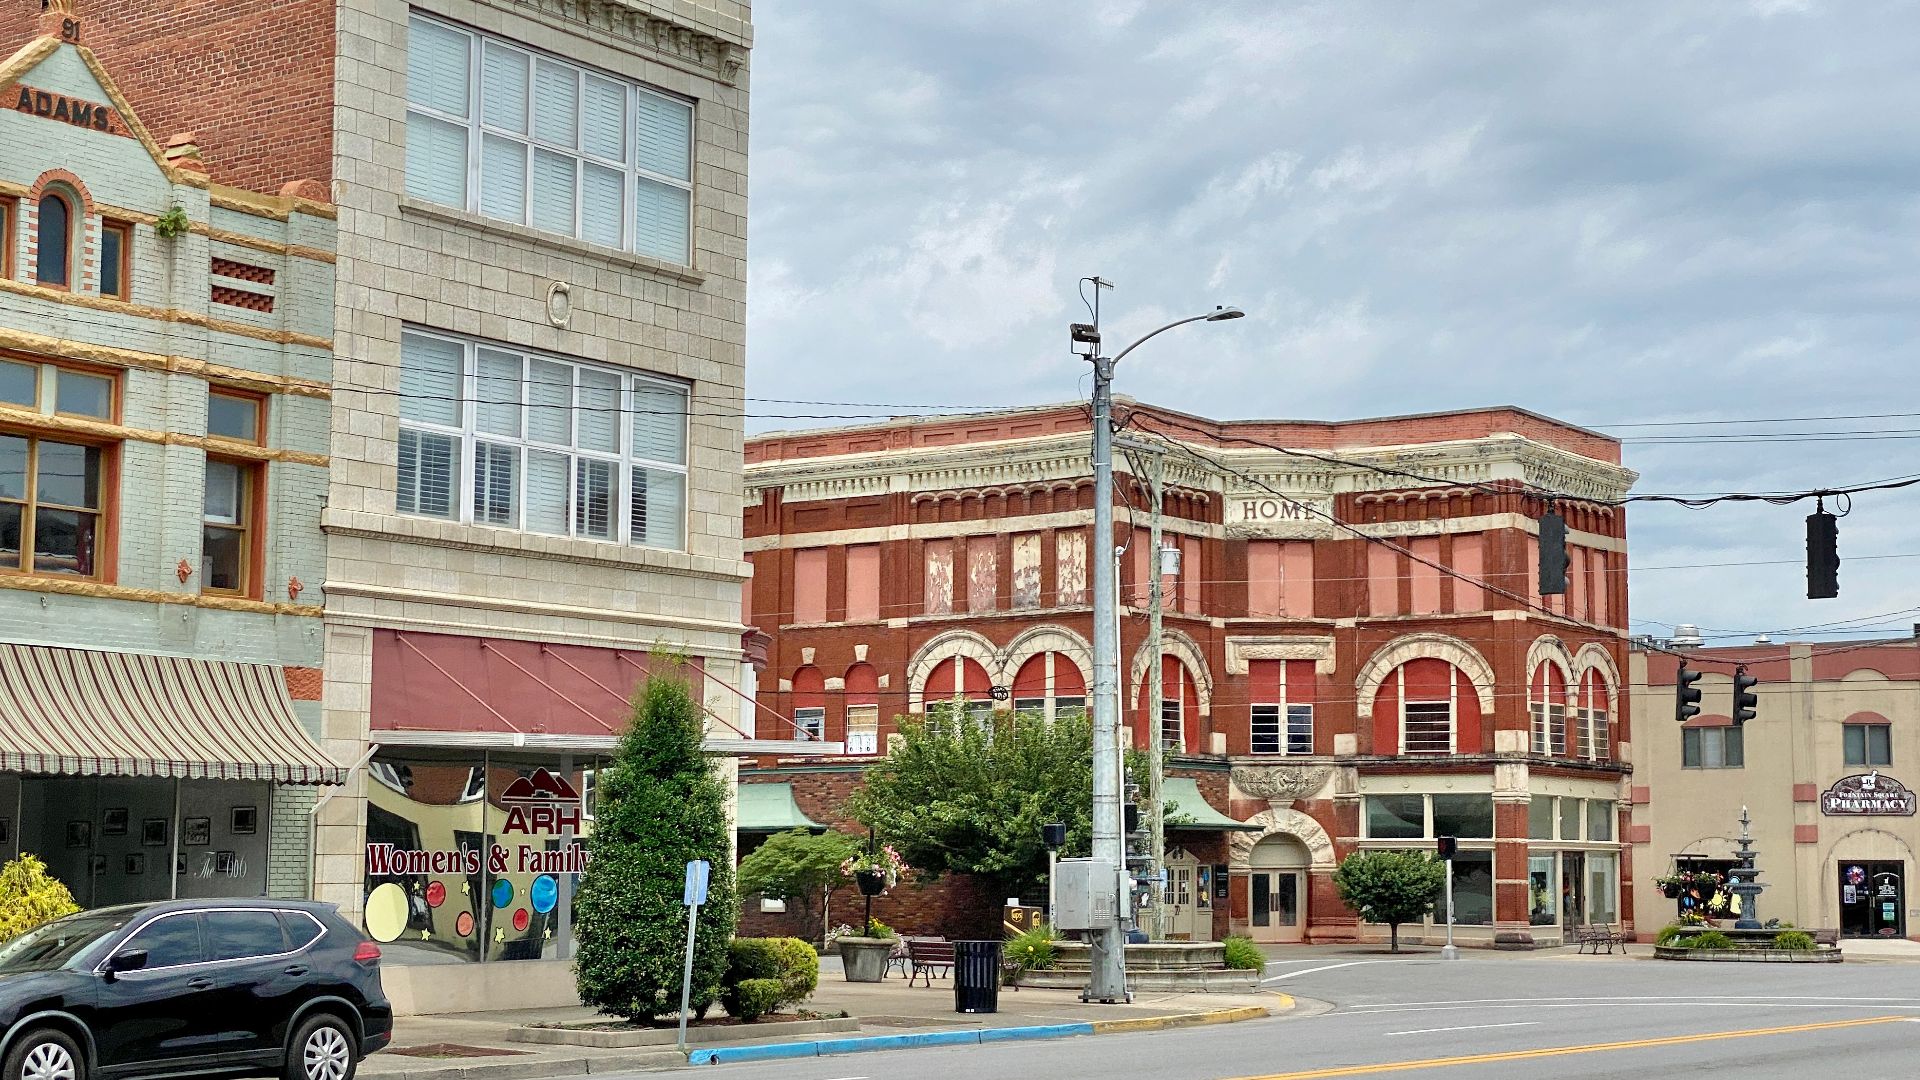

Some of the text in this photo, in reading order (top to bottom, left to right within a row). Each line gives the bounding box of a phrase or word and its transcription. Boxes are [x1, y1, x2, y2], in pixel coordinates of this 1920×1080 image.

[61, 17, 81, 41] 91
[1242, 500, 1316, 520] HOME
[1829, 797, 1908, 810] PHARMACY
[502, 805, 581, 836] ARH
[367, 842, 481, 875] Women's
[487, 842, 511, 875] &
